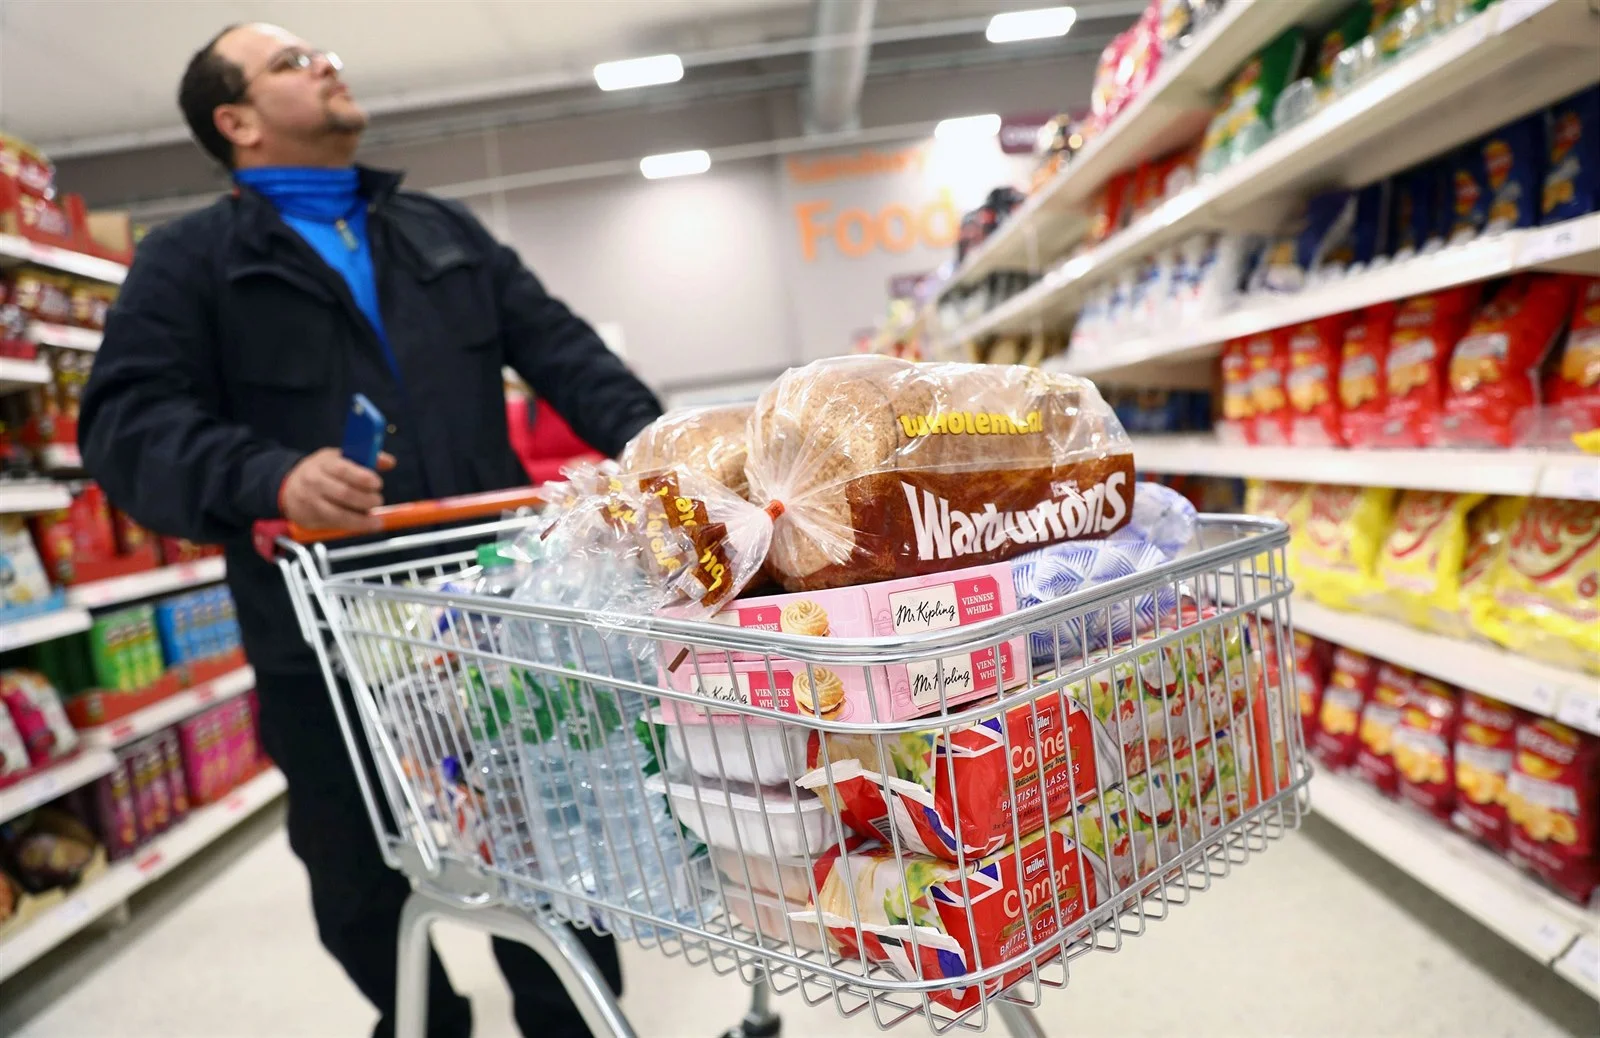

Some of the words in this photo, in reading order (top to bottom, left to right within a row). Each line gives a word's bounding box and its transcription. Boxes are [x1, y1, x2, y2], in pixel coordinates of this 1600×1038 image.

[795, 187, 956, 263] Food
[900, 471, 1127, 561] Warburtons
[973, 584, 979, 593] 6
[961, 592, 995, 606] VIENNESE
[757, 613, 763, 622] 6
[895, 604, 916, 626] Mr
[916, 600, 956, 626] Kipling
[965, 602, 993, 616] WHIRLS
[744, 622, 779, 632] ENNESE
[987, 648, 993, 657] 6
[976, 654, 1008, 671] VIENNSE
[913, 673, 932, 697] Mr
[933, 667, 971, 693] pling
[979, 666, 1006, 681] WHIS
[754, 688, 791, 697] VIENESE
[759, 699, 789, 708] WHLS
[1031, 715, 1050, 733] ller
[1010, 726, 1073, 774] Cone
[1001, 785, 1039, 812] BTISH
[1045, 763, 1081, 789] LASSS
[1016, 803, 1028, 814] TON
[1026, 857, 1046, 875] müller
[1003, 864, 1070, 918] Corner
[999, 926, 1033, 956] BRITIS
[1035, 900, 1079, 931] CLASICS
